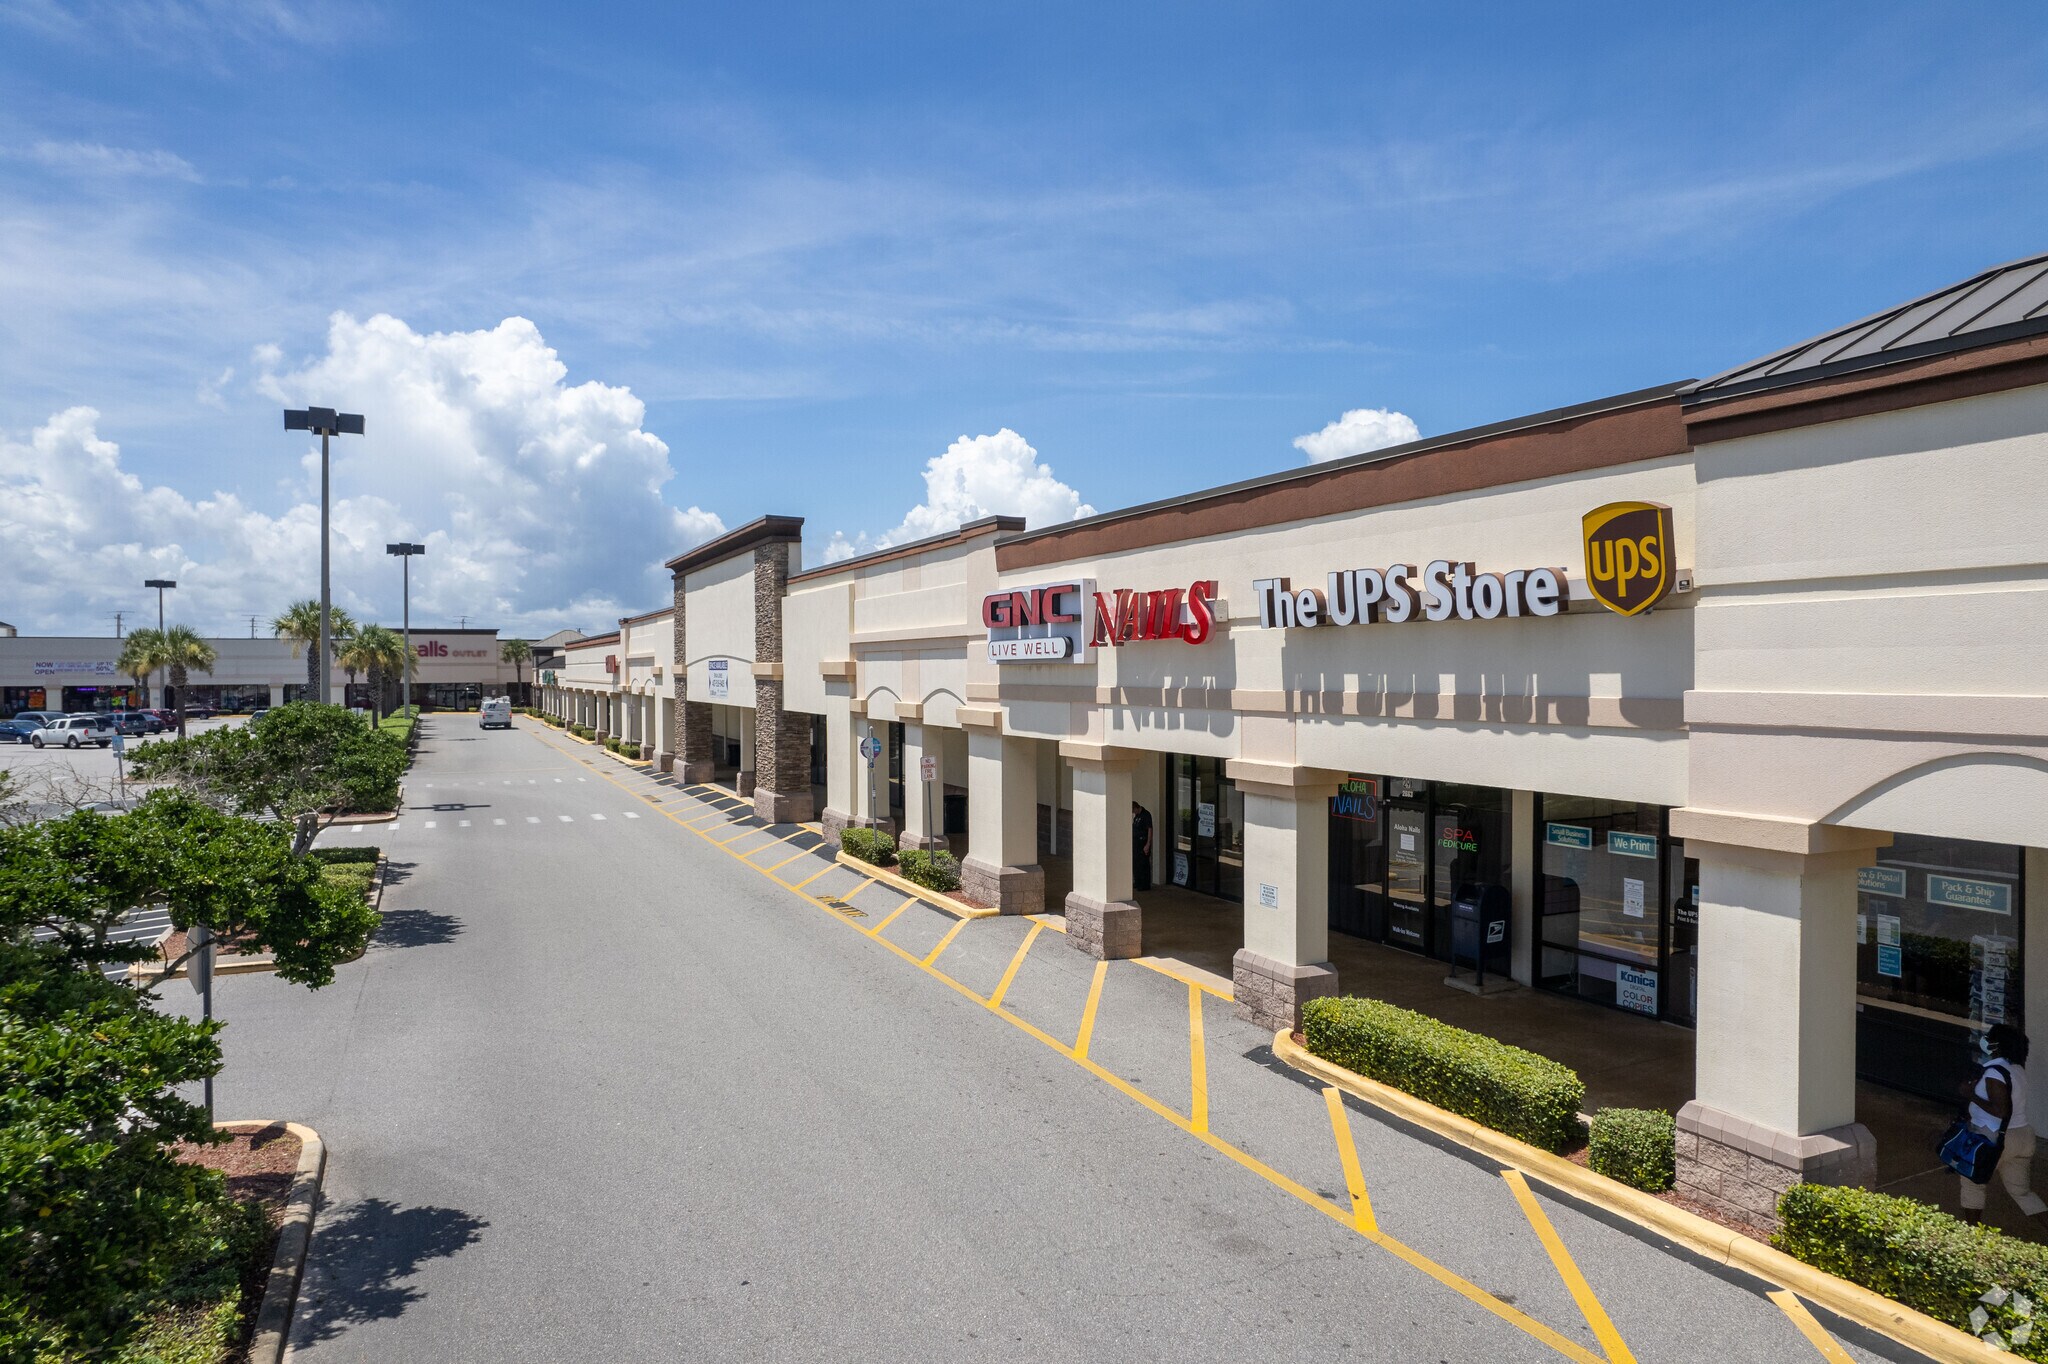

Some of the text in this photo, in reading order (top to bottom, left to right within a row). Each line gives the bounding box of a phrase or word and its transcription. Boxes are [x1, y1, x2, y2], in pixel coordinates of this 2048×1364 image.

[1253, 559, 1568, 628] The UPS Store
[983, 584, 1081, 628] GNC
[1089, 580, 1218, 647] NAILS
[417, 641, 448, 657] alls
[991, 641, 1059, 656] LIVE WELL
[1341, 781, 1366, 794] ALOHA
[1333, 795, 1375, 819] NAILS
[1394, 824, 1421, 834] Aloha Nails
[1443, 828, 1474, 842] SPA
[1565, 829, 1587, 838] Business
[1438, 839, 1477, 852] PEDICURE
[1614, 837, 1651, 852] We Print
[1877, 872, 1900, 882] Postal
[1942, 881, 1995, 898] Pack & Ship
[1945, 891, 1992, 905] Guarantee
[1620, 970, 1656, 988] Konica
[1623, 990, 1653, 1004] COLOR
[1622, 999, 1654, 1014] COPIES
